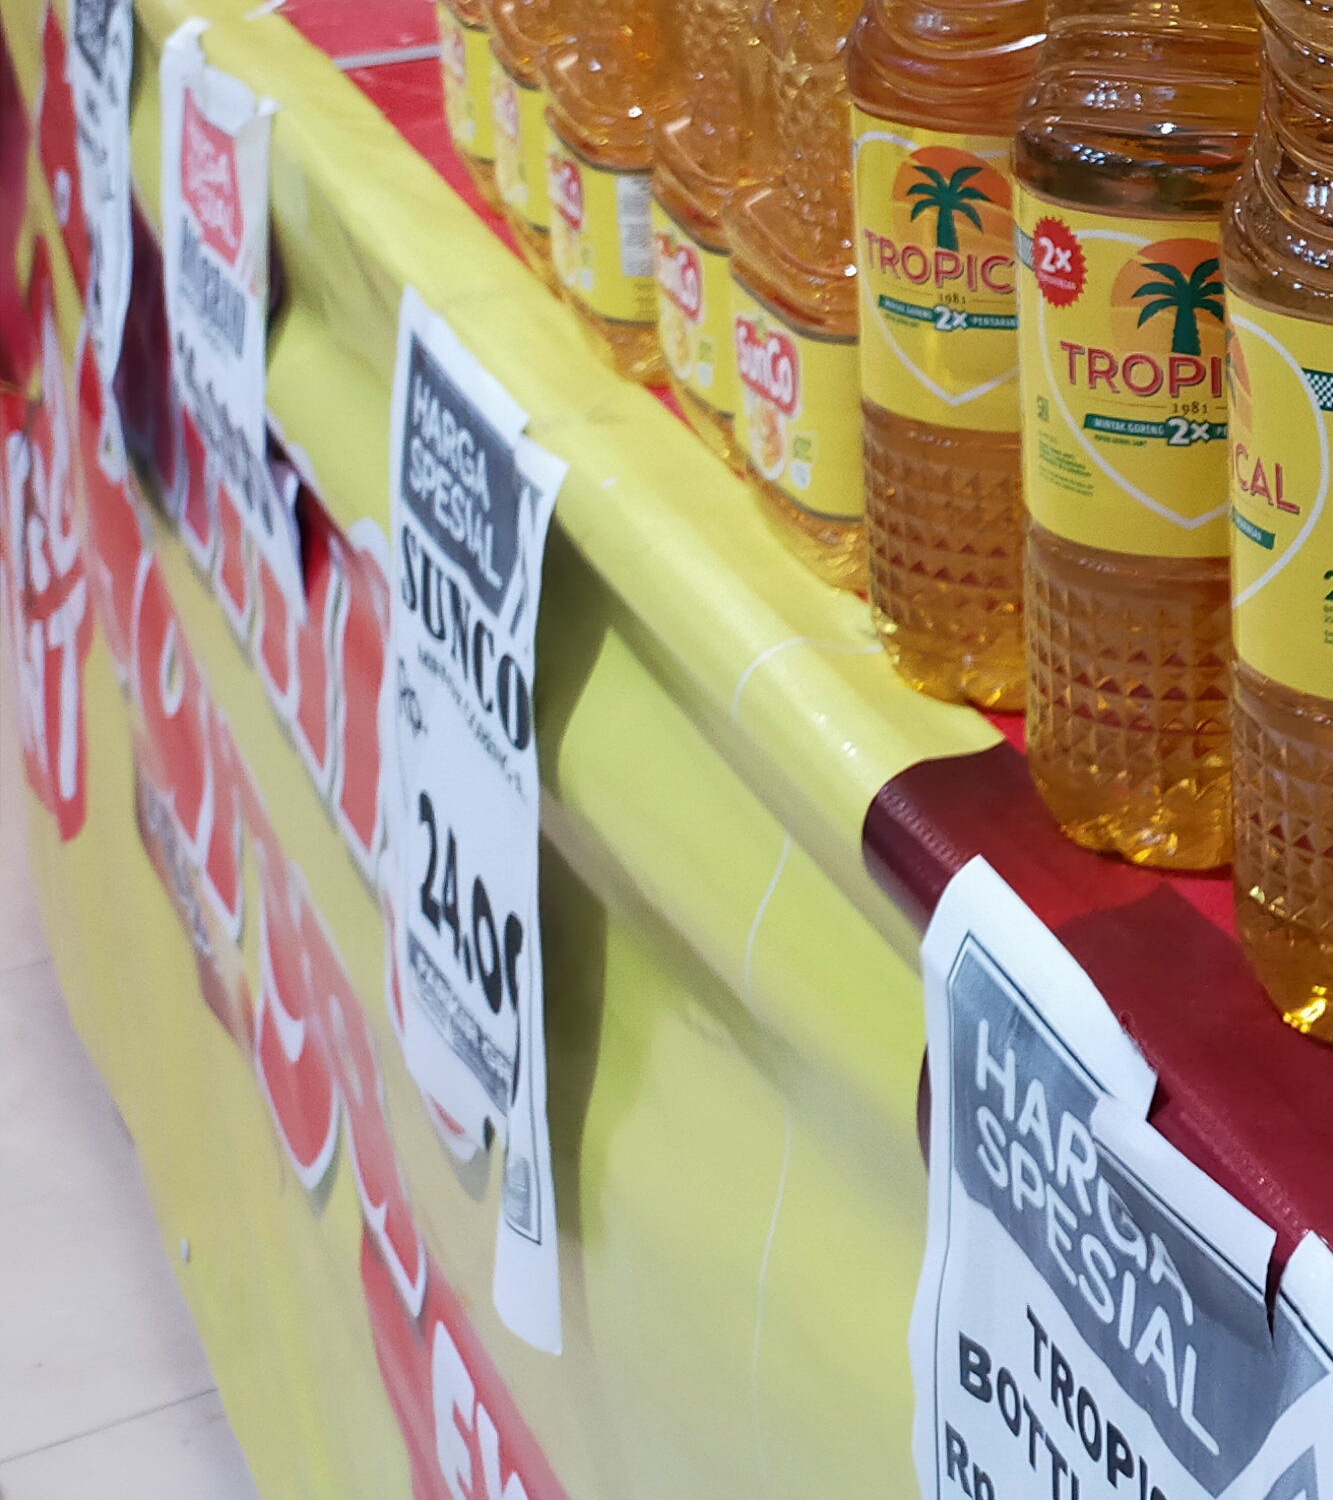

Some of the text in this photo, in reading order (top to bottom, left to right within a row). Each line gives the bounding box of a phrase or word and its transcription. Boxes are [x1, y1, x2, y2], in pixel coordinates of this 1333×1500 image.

[1038, 237, 1073, 274] 2X
[933, 305, 969, 331] 2X
[1059, 340, 1222, 399] TROPI
[1172, 401, 1209, 416] 1981
[413, 375, 491, 514] HARGA
[1167, 416, 1210, 446] 2X
[408, 437, 503, 589] SPESIAL
[401, 524, 531, 753] SUNCO
[976, 1018, 1194, 1326] HARGA
[976, 1105, 1221, 1457] SPESIAL
